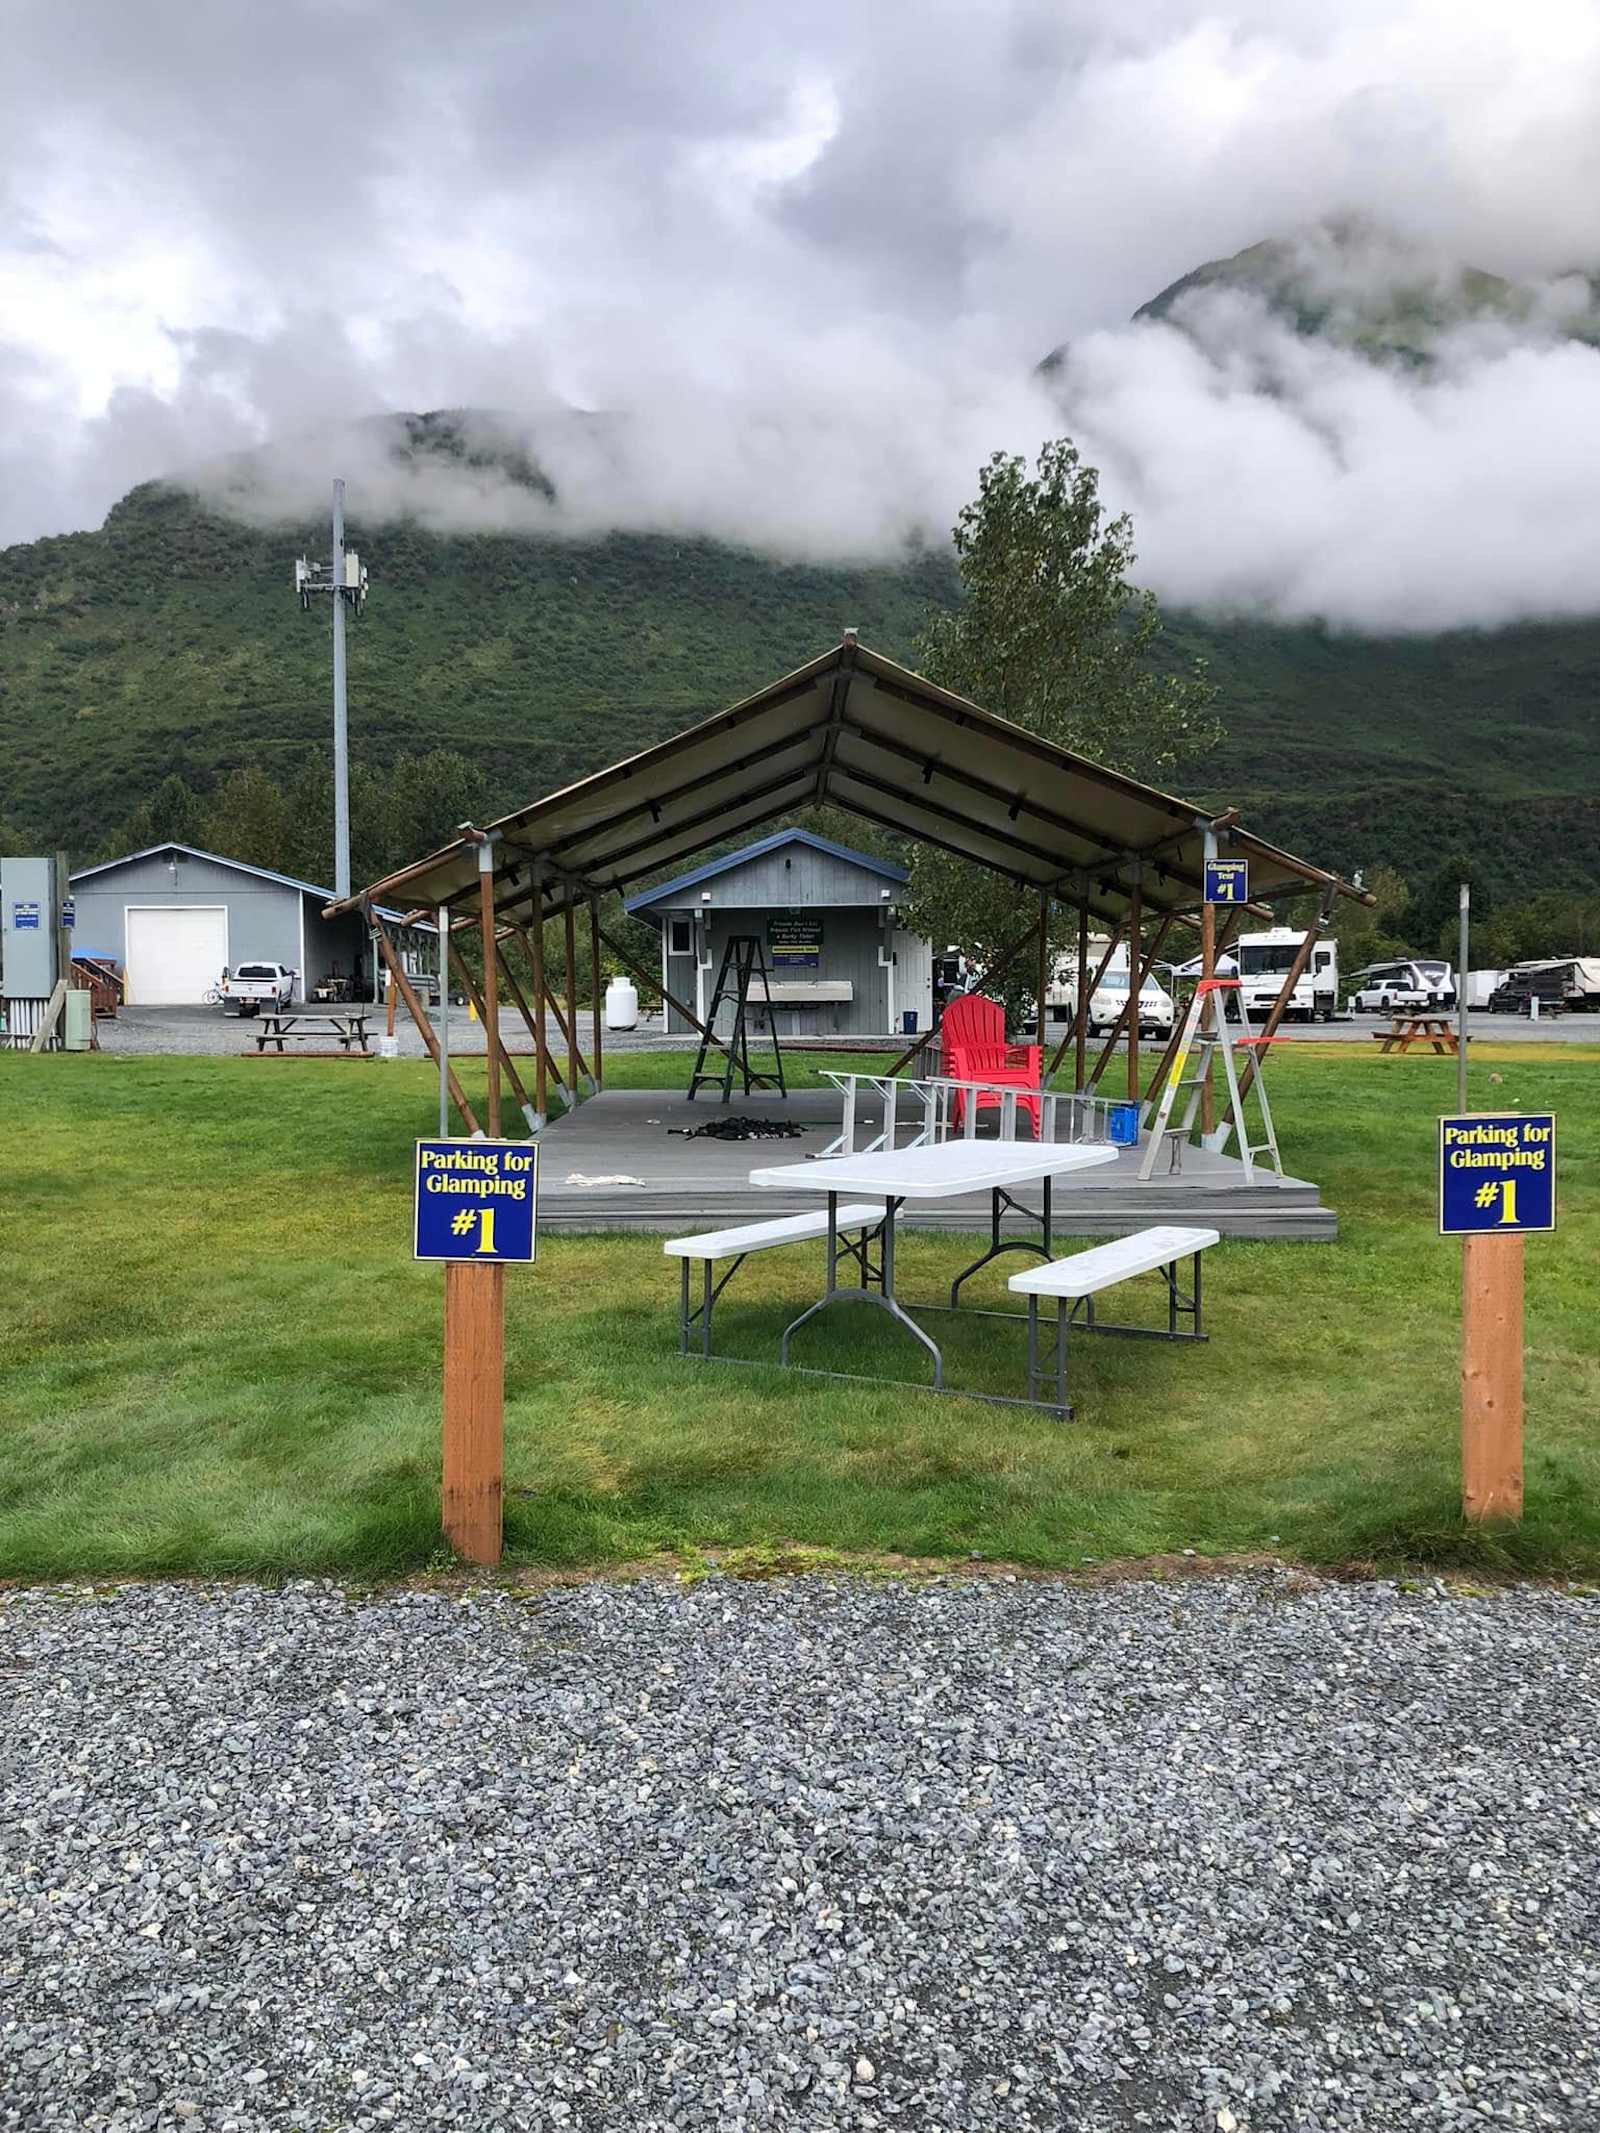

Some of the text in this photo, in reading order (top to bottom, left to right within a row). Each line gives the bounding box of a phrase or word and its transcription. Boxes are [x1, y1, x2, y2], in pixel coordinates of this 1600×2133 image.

[1207, 863, 1245, 872] Glamping
[1217, 883, 1234, 900] #1
[1444, 1123, 1551, 1148] Parking for
[421, 1150, 533, 1175] Parking for
[1450, 1147, 1545, 1170] Glamping
[426, 1173, 526, 1200] Glamping
[1474, 1180, 1520, 1224] #1
[450, 1207, 499, 1253] #1
